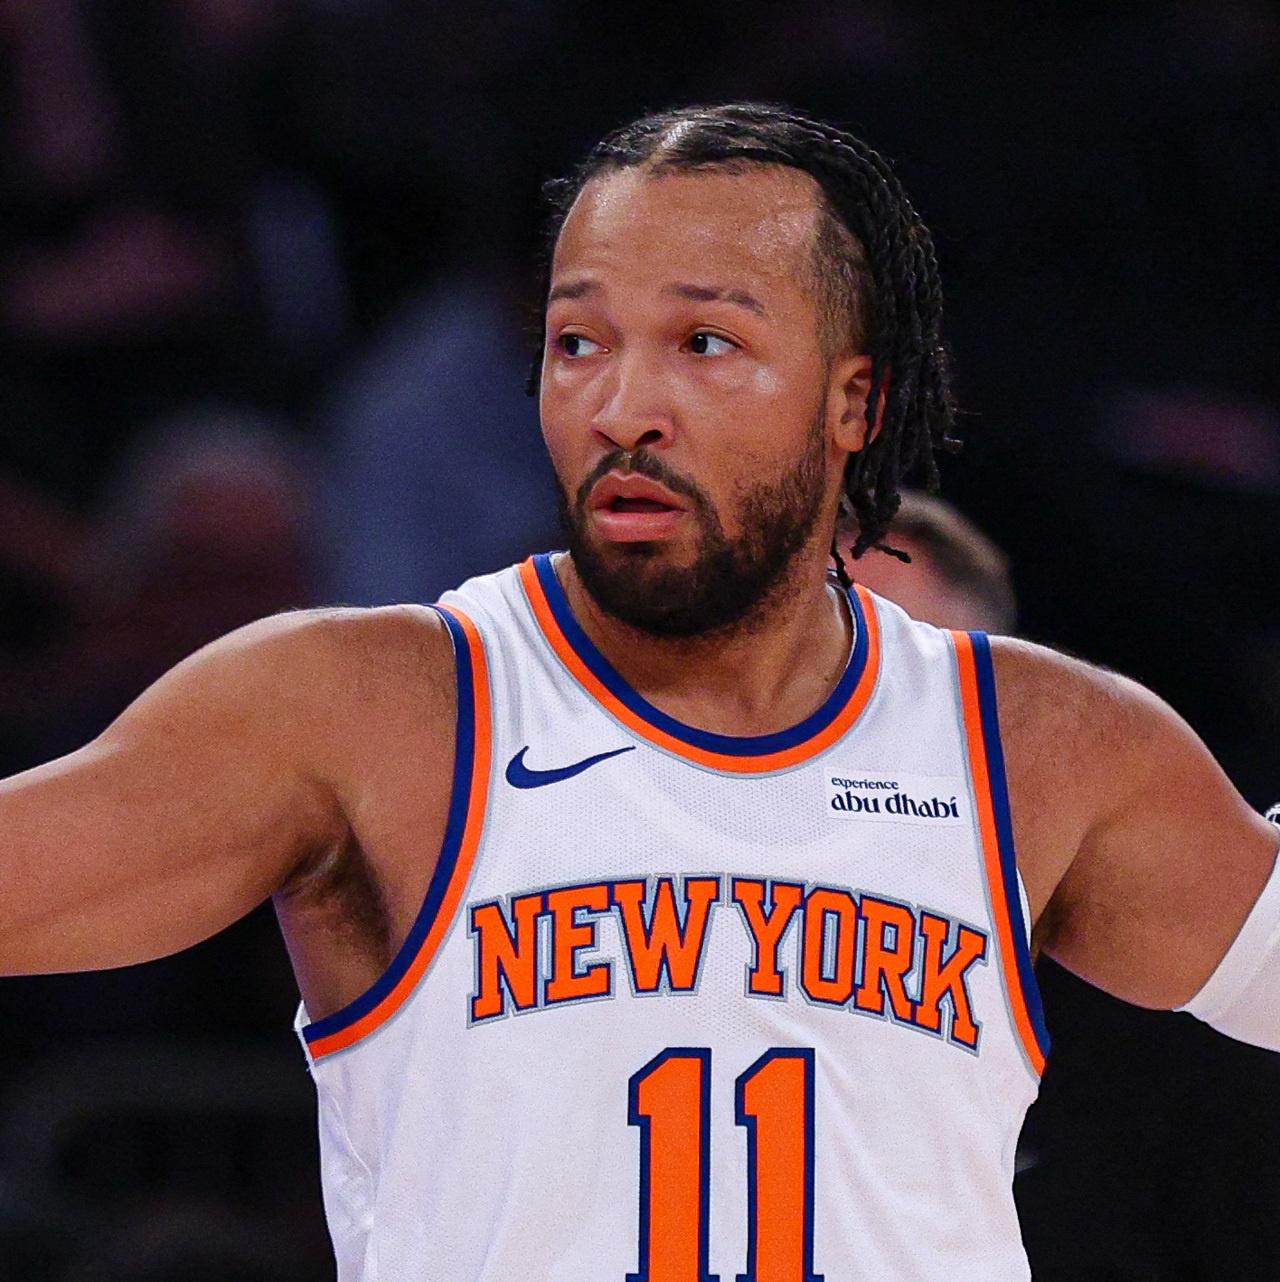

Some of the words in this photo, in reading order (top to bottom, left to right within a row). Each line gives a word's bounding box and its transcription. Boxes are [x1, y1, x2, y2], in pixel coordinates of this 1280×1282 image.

[831, 776, 899, 790] experience
[831, 791, 881, 814] abu
[885, 793, 960, 818] dhabi
[466, 872, 724, 1028] NEW
[727, 872, 991, 1056] YORK
